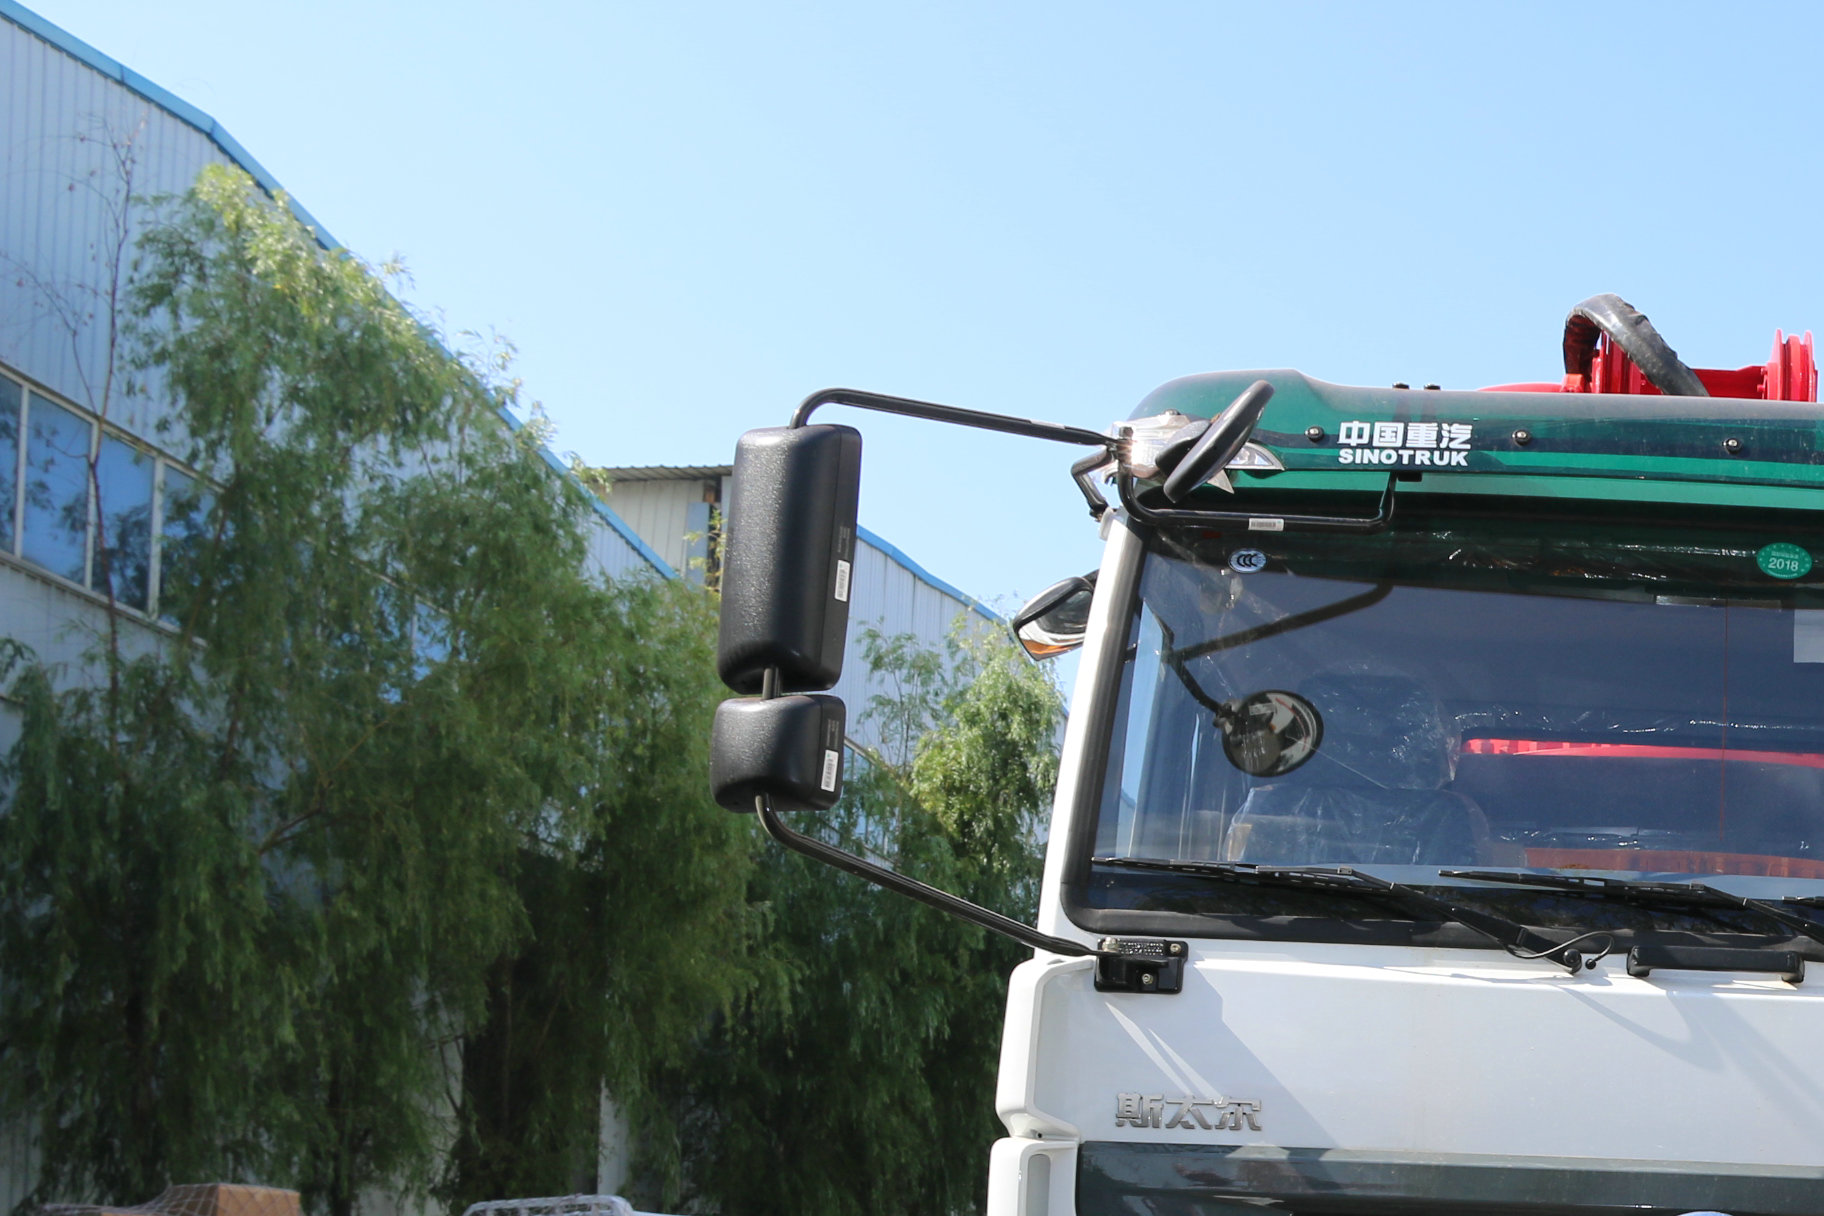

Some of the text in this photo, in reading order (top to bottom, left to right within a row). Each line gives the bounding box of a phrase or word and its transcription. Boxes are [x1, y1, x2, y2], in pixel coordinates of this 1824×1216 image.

[1337, 421, 1473, 449] 中国重汽
[1338, 448, 1469, 467] SINOTRUK
[1768, 557, 1799, 572] 2018
[1115, 1092, 1262, 1131] 斯太尔
